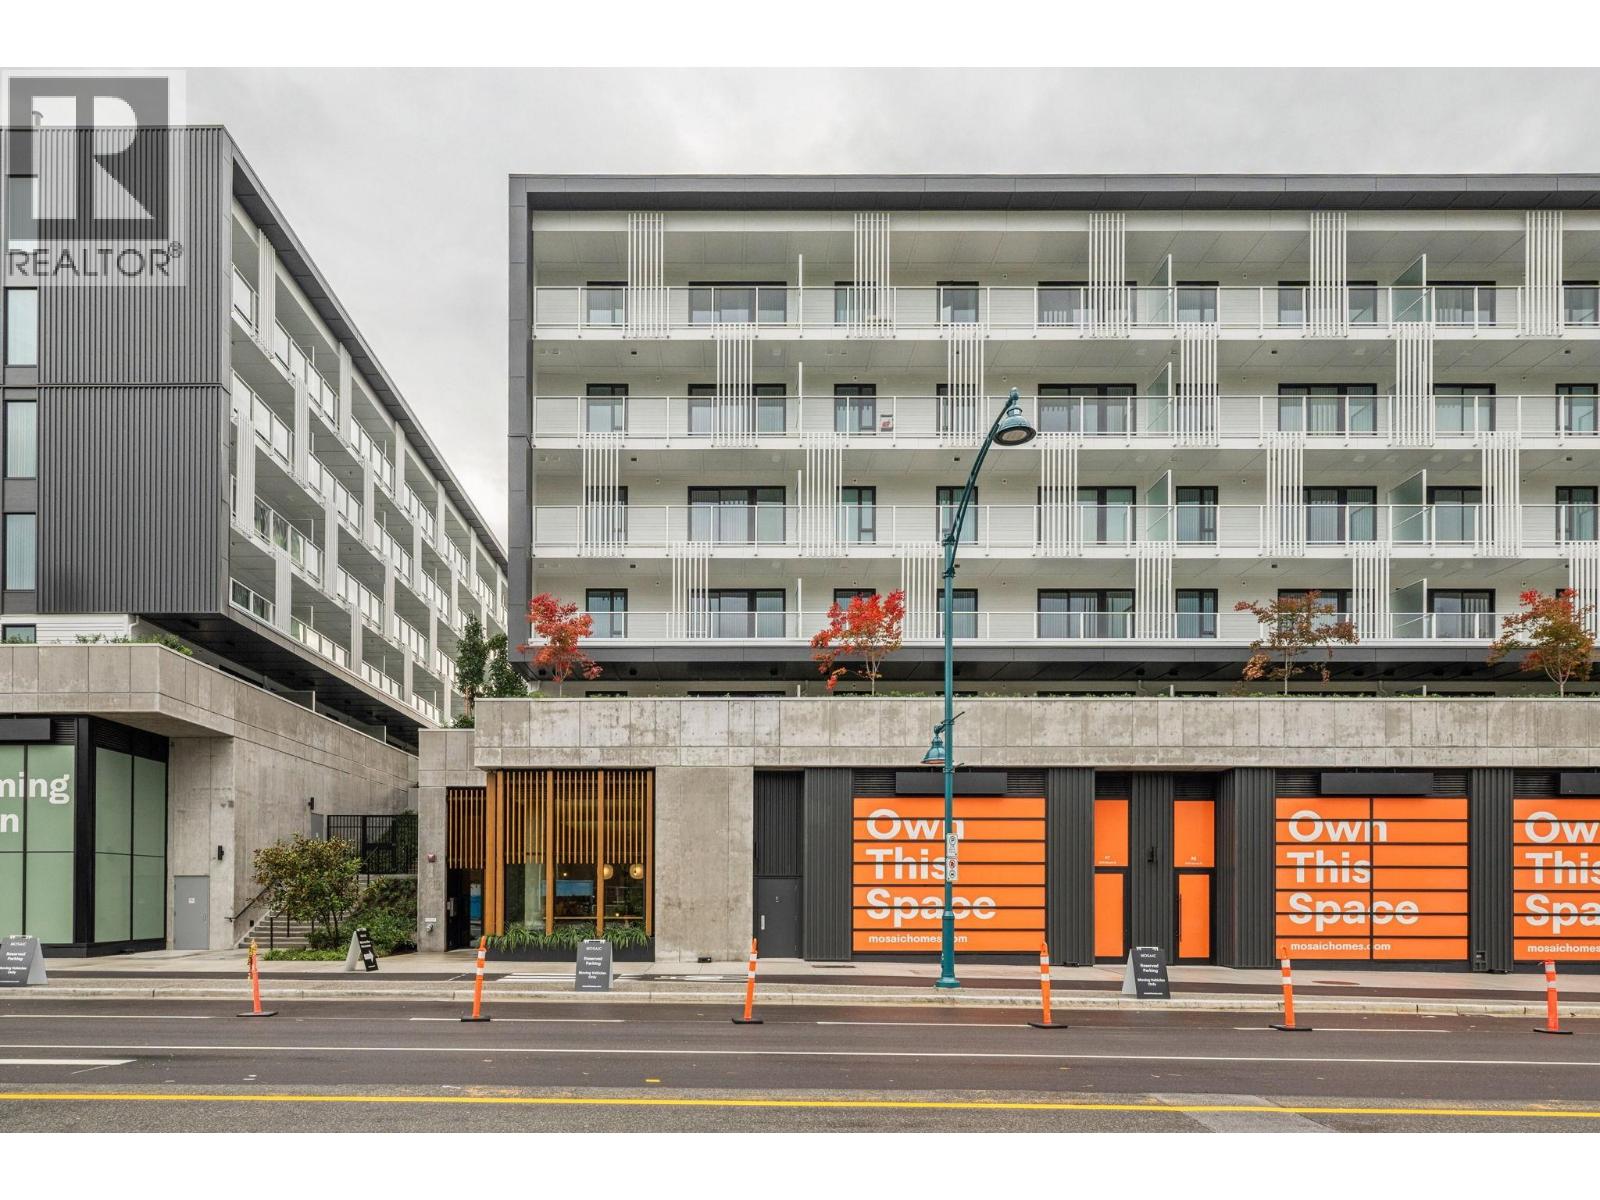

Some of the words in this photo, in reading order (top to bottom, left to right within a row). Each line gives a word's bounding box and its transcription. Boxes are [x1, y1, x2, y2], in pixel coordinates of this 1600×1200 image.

[866, 808, 964, 840] Own
[1288, 810, 1387, 842] Own
[866, 846, 945, 880] This
[1286, 850, 1371, 883] This
[866, 888, 996, 928] Space
[1289, 892, 1419, 932] Space
[1290, 942, 1391, 951] mosaichomes.com
